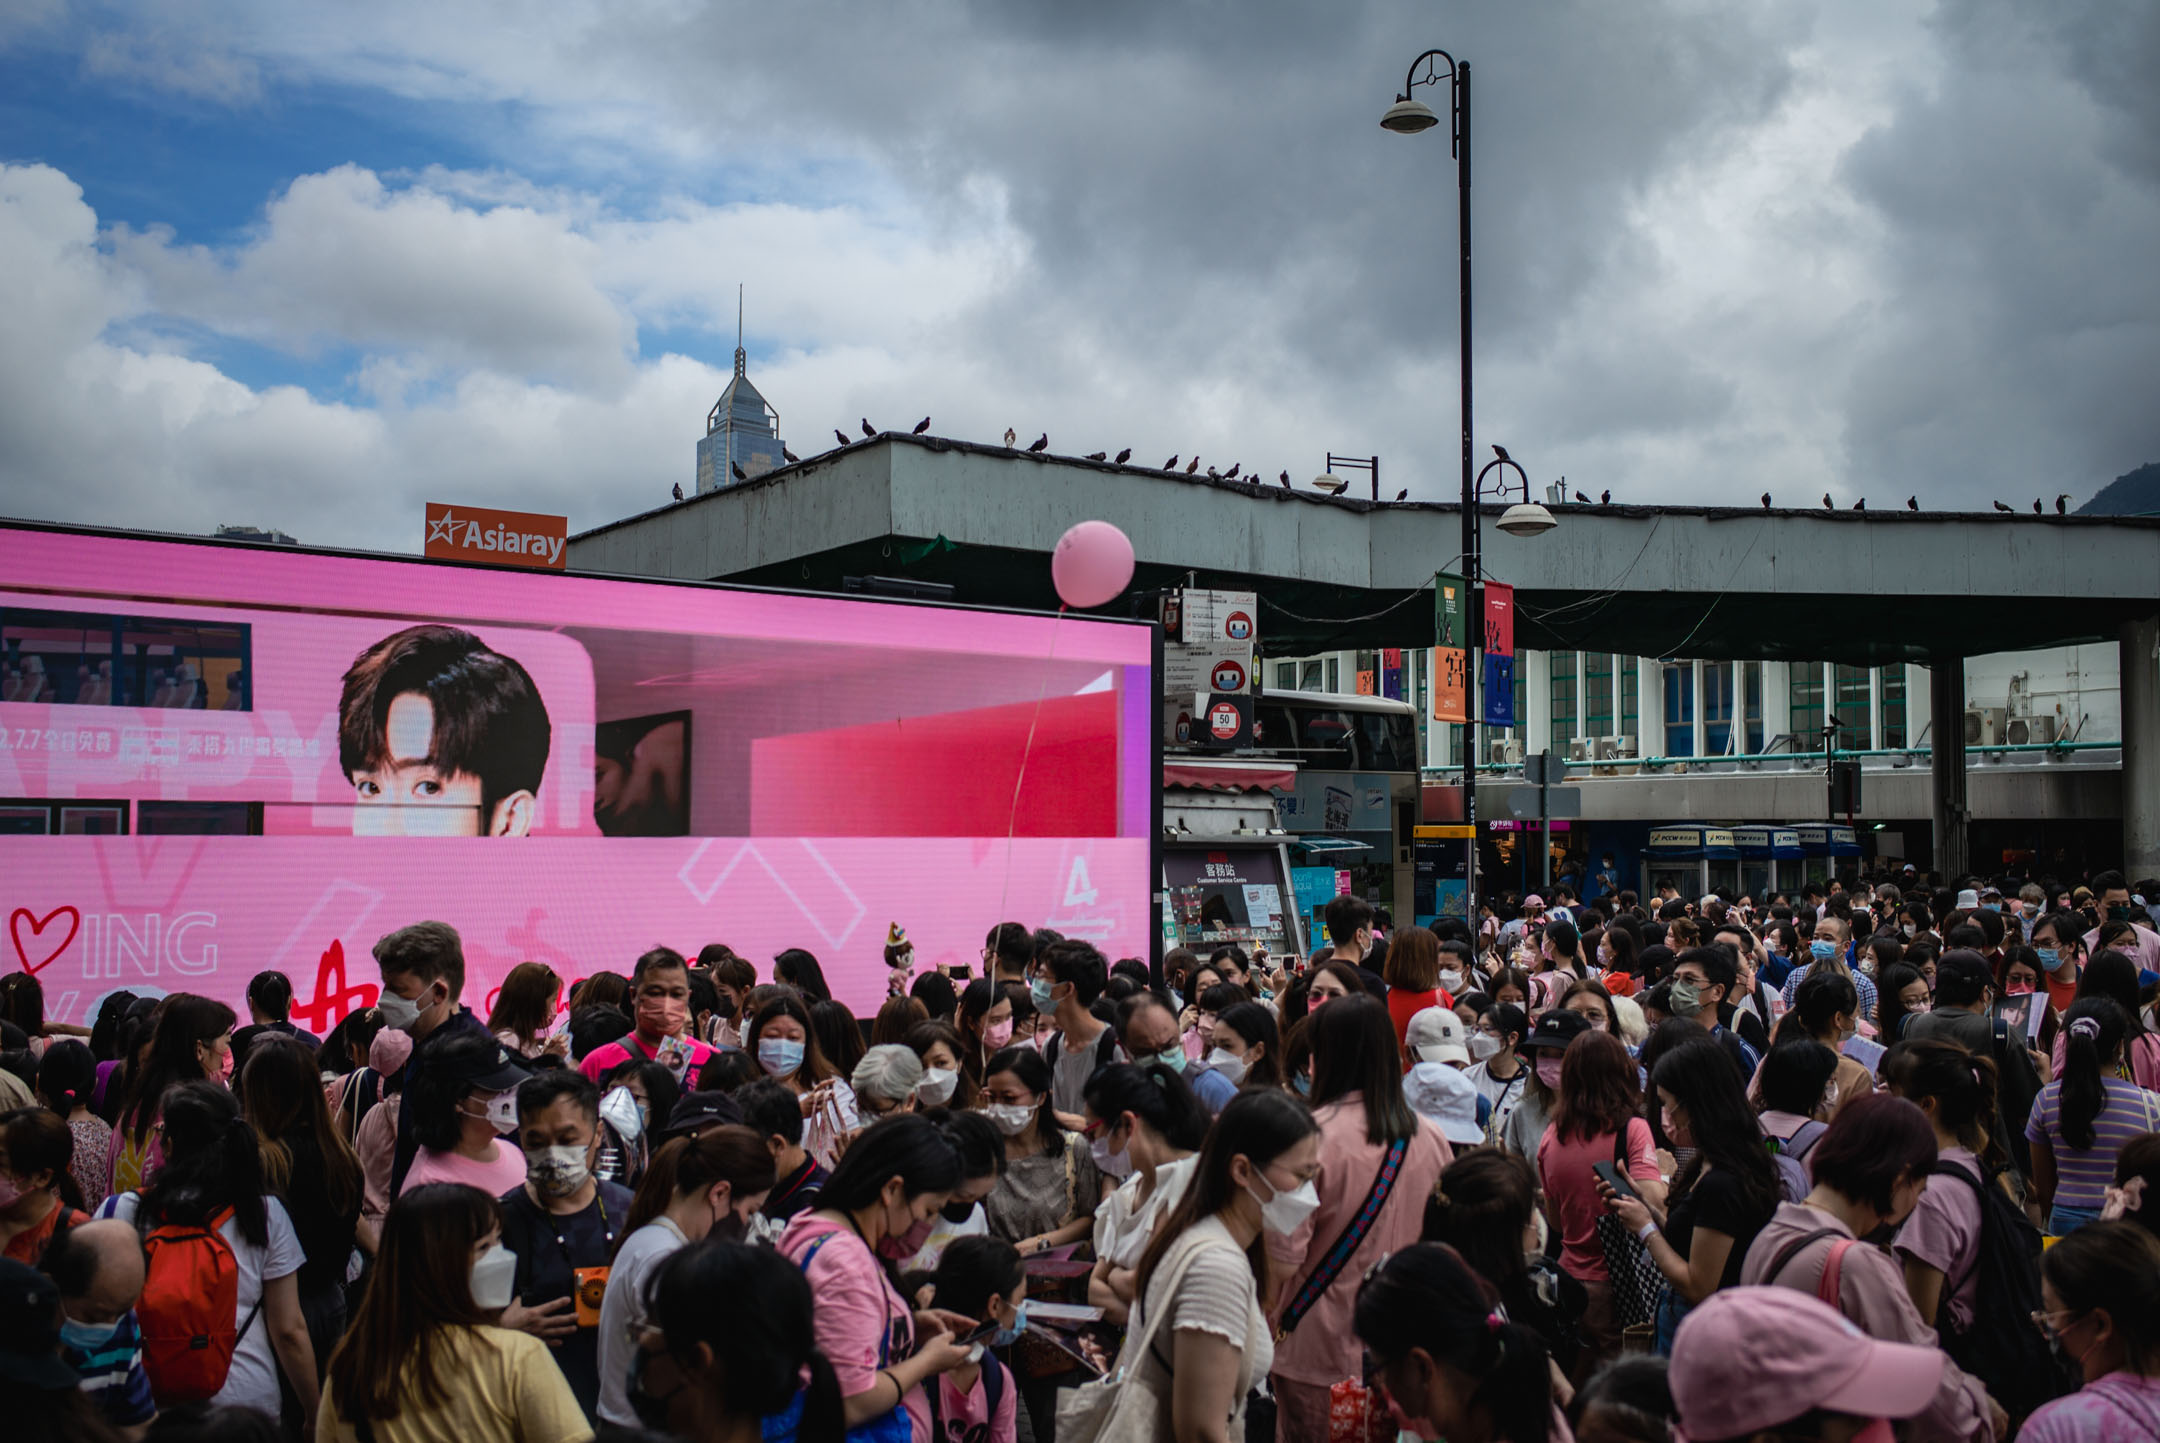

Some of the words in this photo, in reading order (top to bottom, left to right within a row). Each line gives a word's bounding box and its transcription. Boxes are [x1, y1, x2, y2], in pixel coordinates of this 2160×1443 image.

[462, 520, 565, 565] Asiaray
[1219, 714, 1230, 724] 50
[1204, 863, 1236, 877] 客務站
[82, 911, 218, 978] ING
[1292, 1257, 1341, 1316] MARC
[1346, 1147, 1403, 1249] JACOBS
